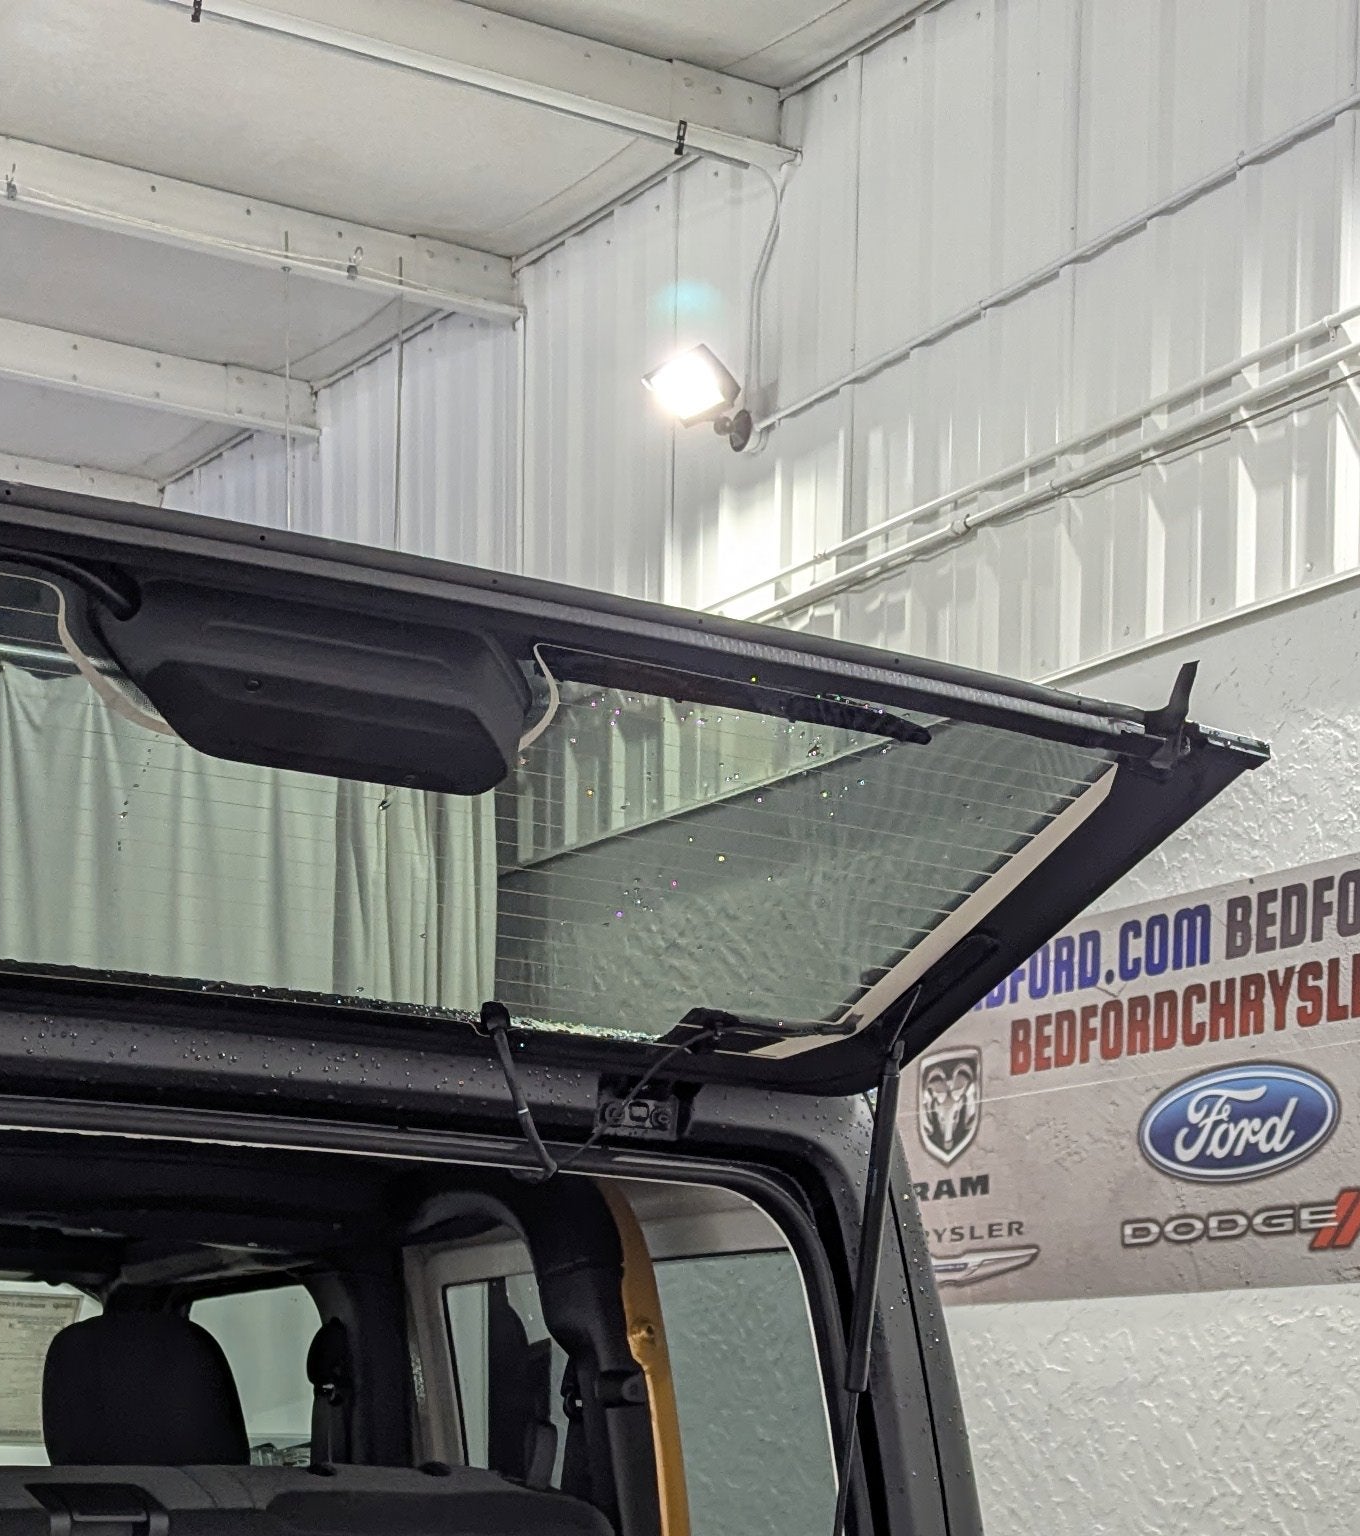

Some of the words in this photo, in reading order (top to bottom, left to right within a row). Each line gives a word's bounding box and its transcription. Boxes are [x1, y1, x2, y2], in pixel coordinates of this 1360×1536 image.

[973, 903, 1212, 1011] FORD.COM
[1174, 1084, 1299, 1163] Ford
[912, 1173, 990, 1202] RAM
[1121, 1201, 1340, 1248] DODGE
